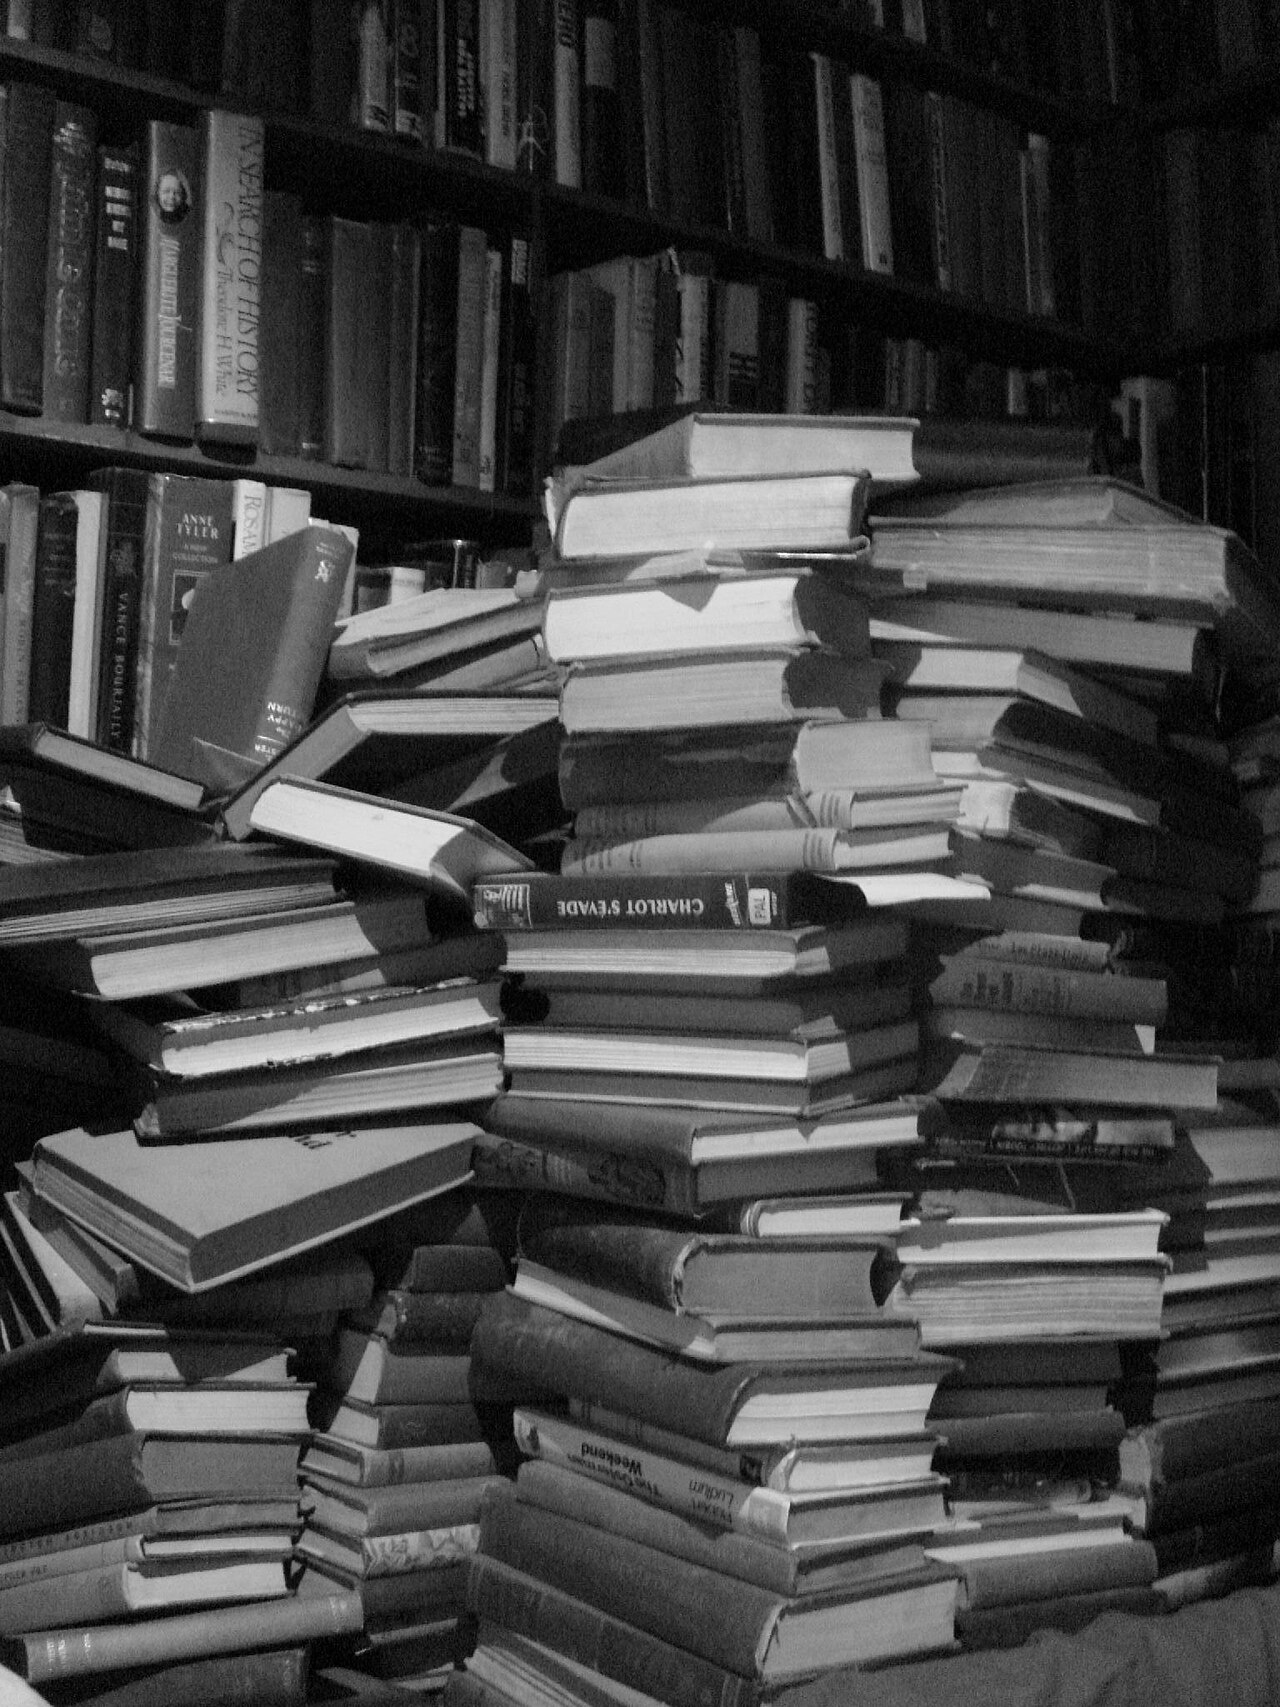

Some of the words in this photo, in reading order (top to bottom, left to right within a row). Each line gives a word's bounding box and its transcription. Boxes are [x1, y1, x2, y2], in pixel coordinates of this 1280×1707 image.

[238, 157, 262, 257] SEARCH
[237, 258, 261, 294] OF
[236, 297, 261, 404] HISTORY
[175, 523, 219, 540] TYLER
[181, 513, 214, 527] ANNE
[115, 592, 129, 645] VANCE
[110, 654, 126, 740] BOURJAILY
[626, 897, 705, 917] CHARLOT
[580, 1443, 643, 1477] Weekend
[687, 1480, 735, 1507] Ludlum
